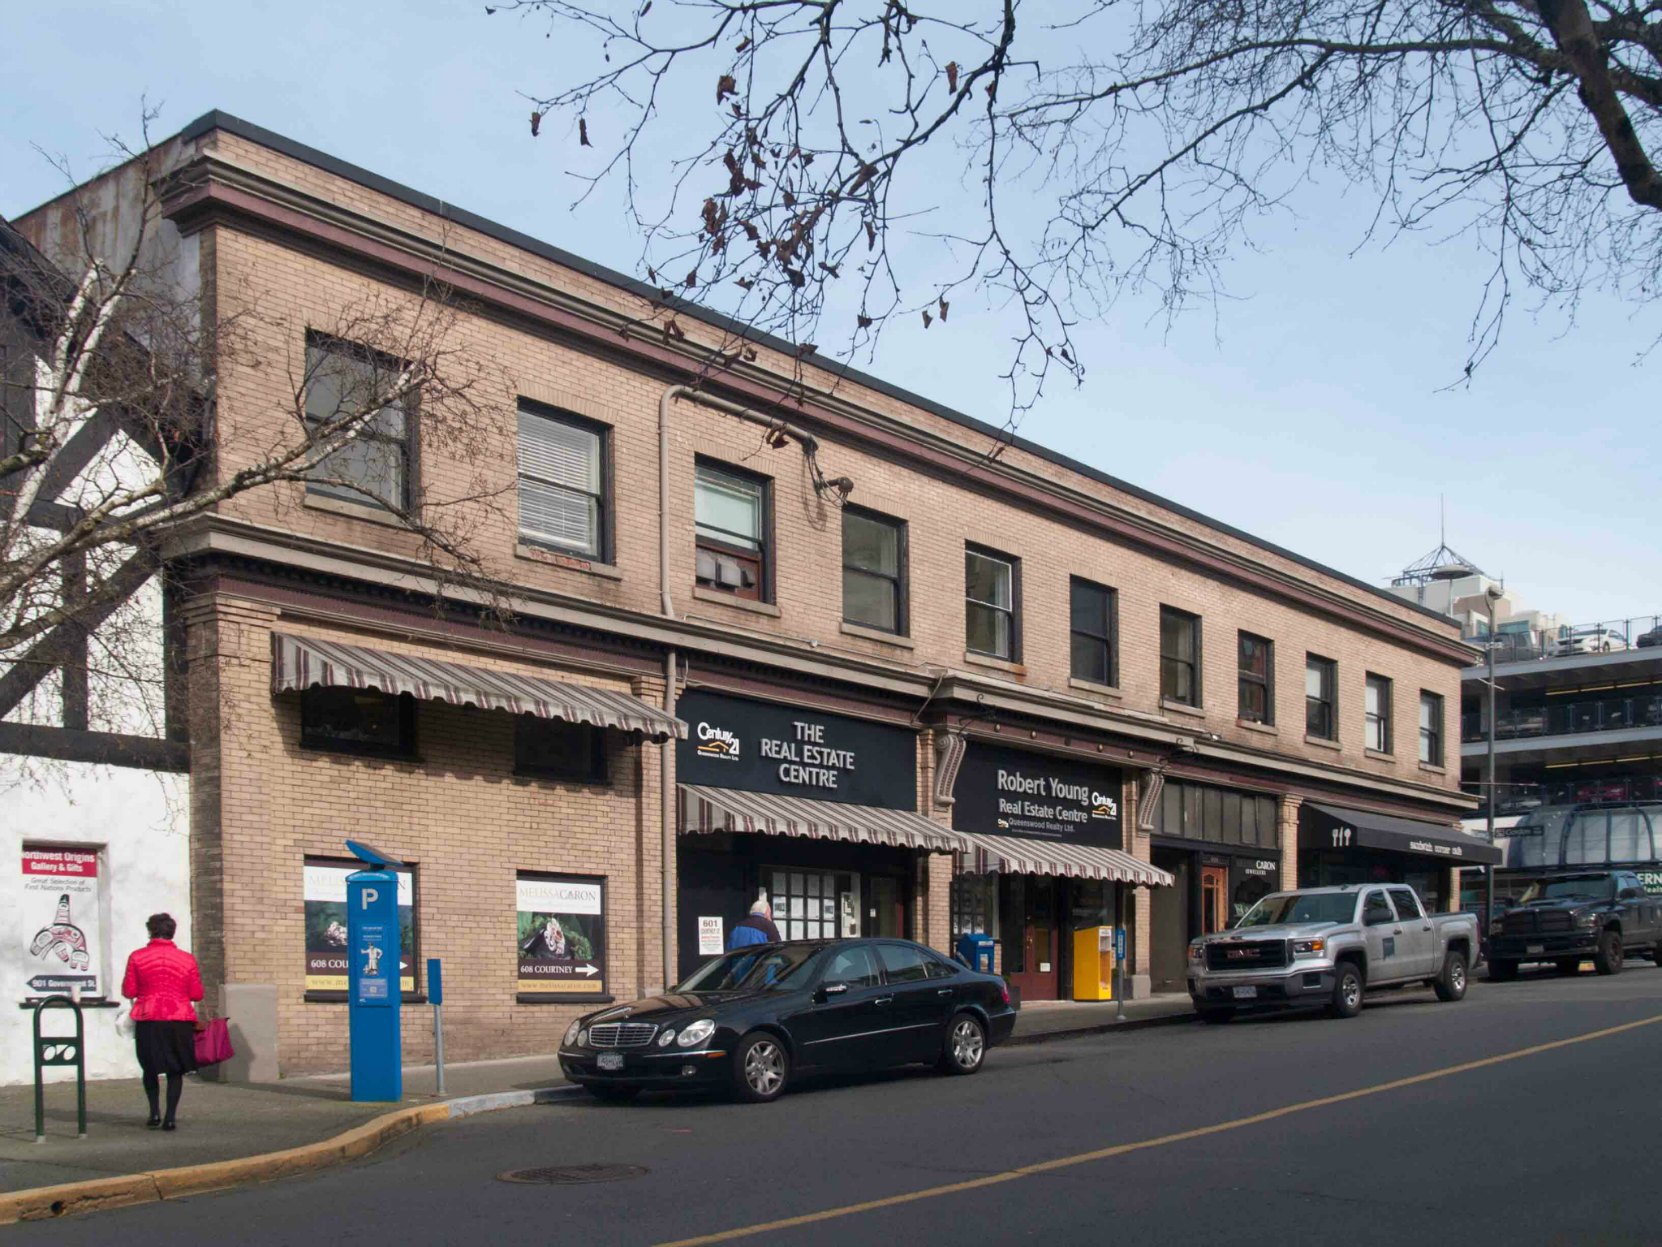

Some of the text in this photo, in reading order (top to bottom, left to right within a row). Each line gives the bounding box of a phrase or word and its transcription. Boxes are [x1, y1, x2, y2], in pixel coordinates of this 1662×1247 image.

[697, 721, 740, 755] Century 21
[792, 721, 824, 743] THE
[760, 738, 855, 769] REAL ESTATE
[779, 763, 838, 788] CENTRE
[997, 769, 1089, 806] Robert Young
[999, 798, 1022, 815] Real
[1023, 801, 1054, 819] Estate
[1055, 806, 1088, 823] Centre
[30, 861, 84, 873] Gallery & Gifts
[1255, 859, 1276, 871] CARON
[361, 888, 379, 910] P
[702, 919, 718, 928] 601
[310, 959, 327, 969] 608
[520, 965, 573, 974] 608 COURTNEY
